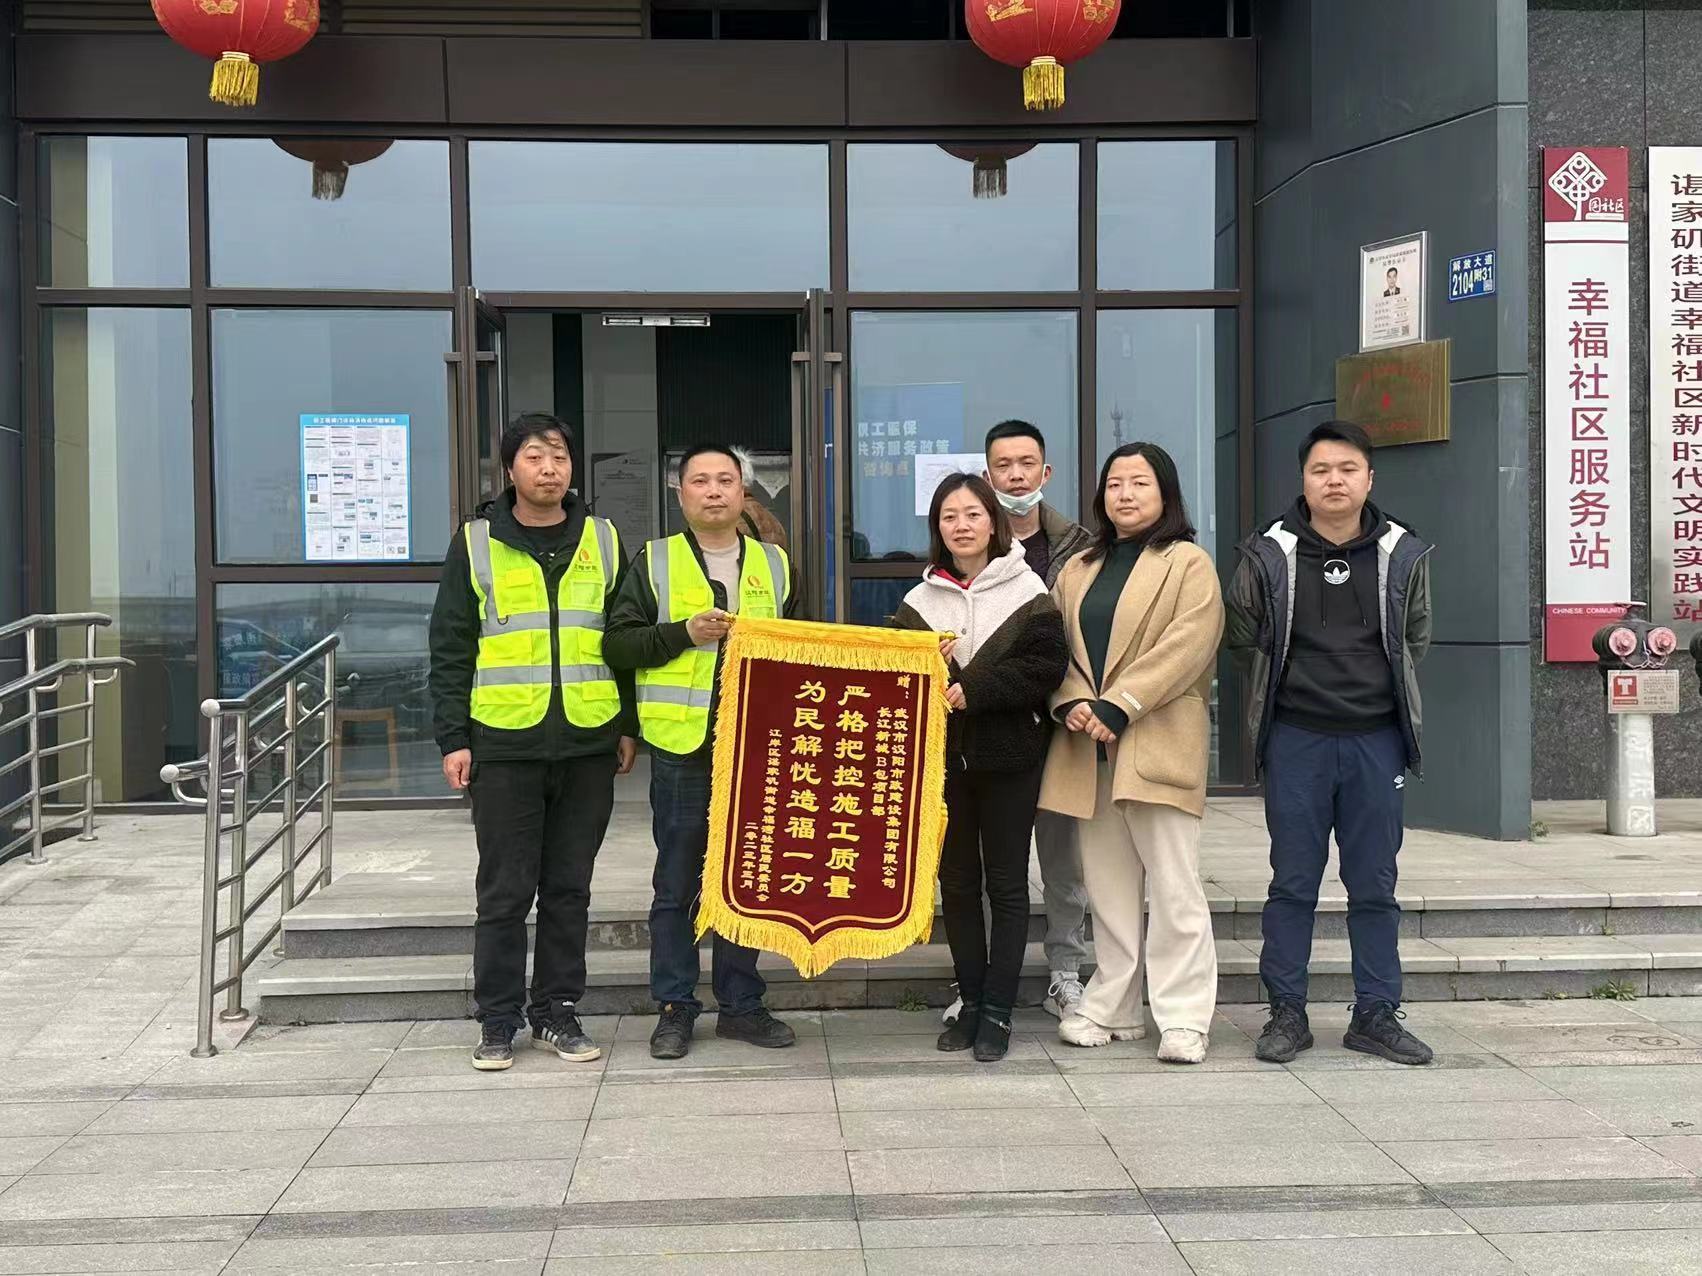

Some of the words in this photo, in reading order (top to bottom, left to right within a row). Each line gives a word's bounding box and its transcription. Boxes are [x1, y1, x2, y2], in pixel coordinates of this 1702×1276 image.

[1453, 254, 1492, 272] 解放大道
[1568, 278, 1610, 569] 幸福社区服务站
[1552, 607, 1584, 615] CHINESE
[1586, 607, 1627, 615] COMMUNITY
[780, 680, 826, 895] 为民解忧造福一方
[823, 685, 871, 899] 严格把控施工质量
[871, 707, 892, 816] 长江新城B包项目部
